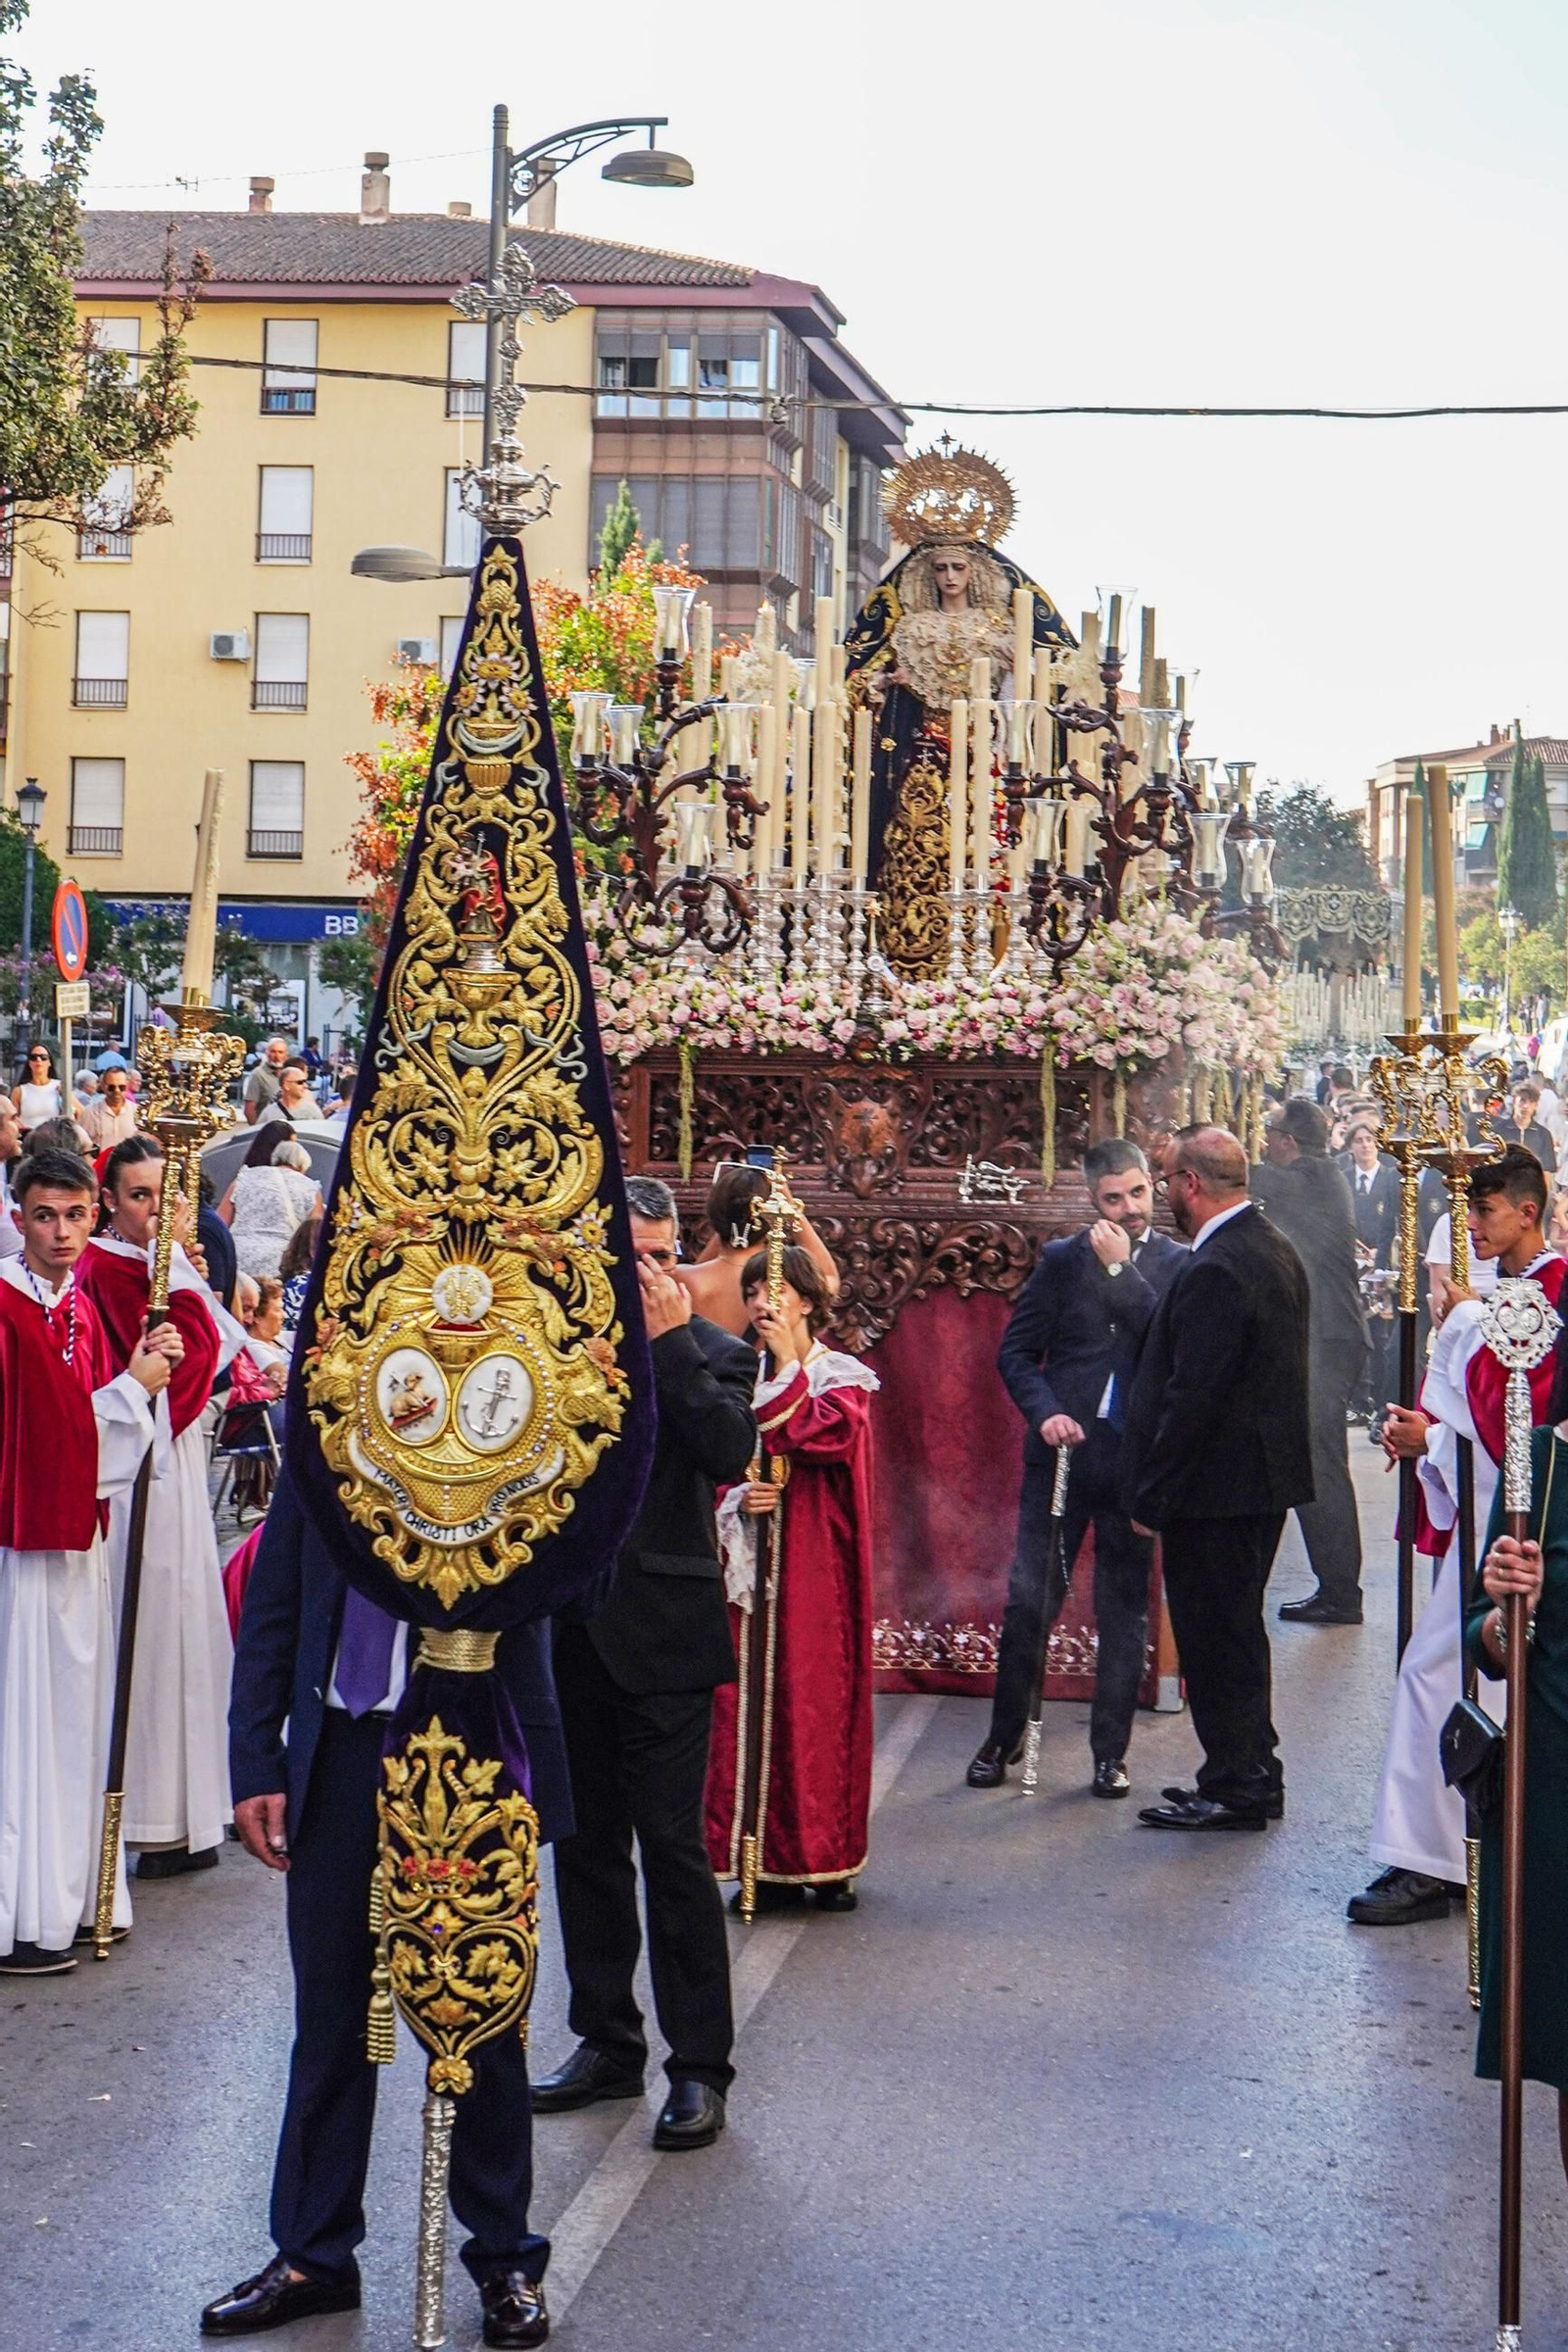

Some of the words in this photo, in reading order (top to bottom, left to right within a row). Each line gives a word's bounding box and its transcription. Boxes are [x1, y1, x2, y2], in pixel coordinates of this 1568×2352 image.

[374, 1470, 408, 1504] MATER
[405, 1511, 457, 1542] CHRISTI
[464, 1517, 493, 1538] ORA
[490, 1492, 508, 1512] PRO
